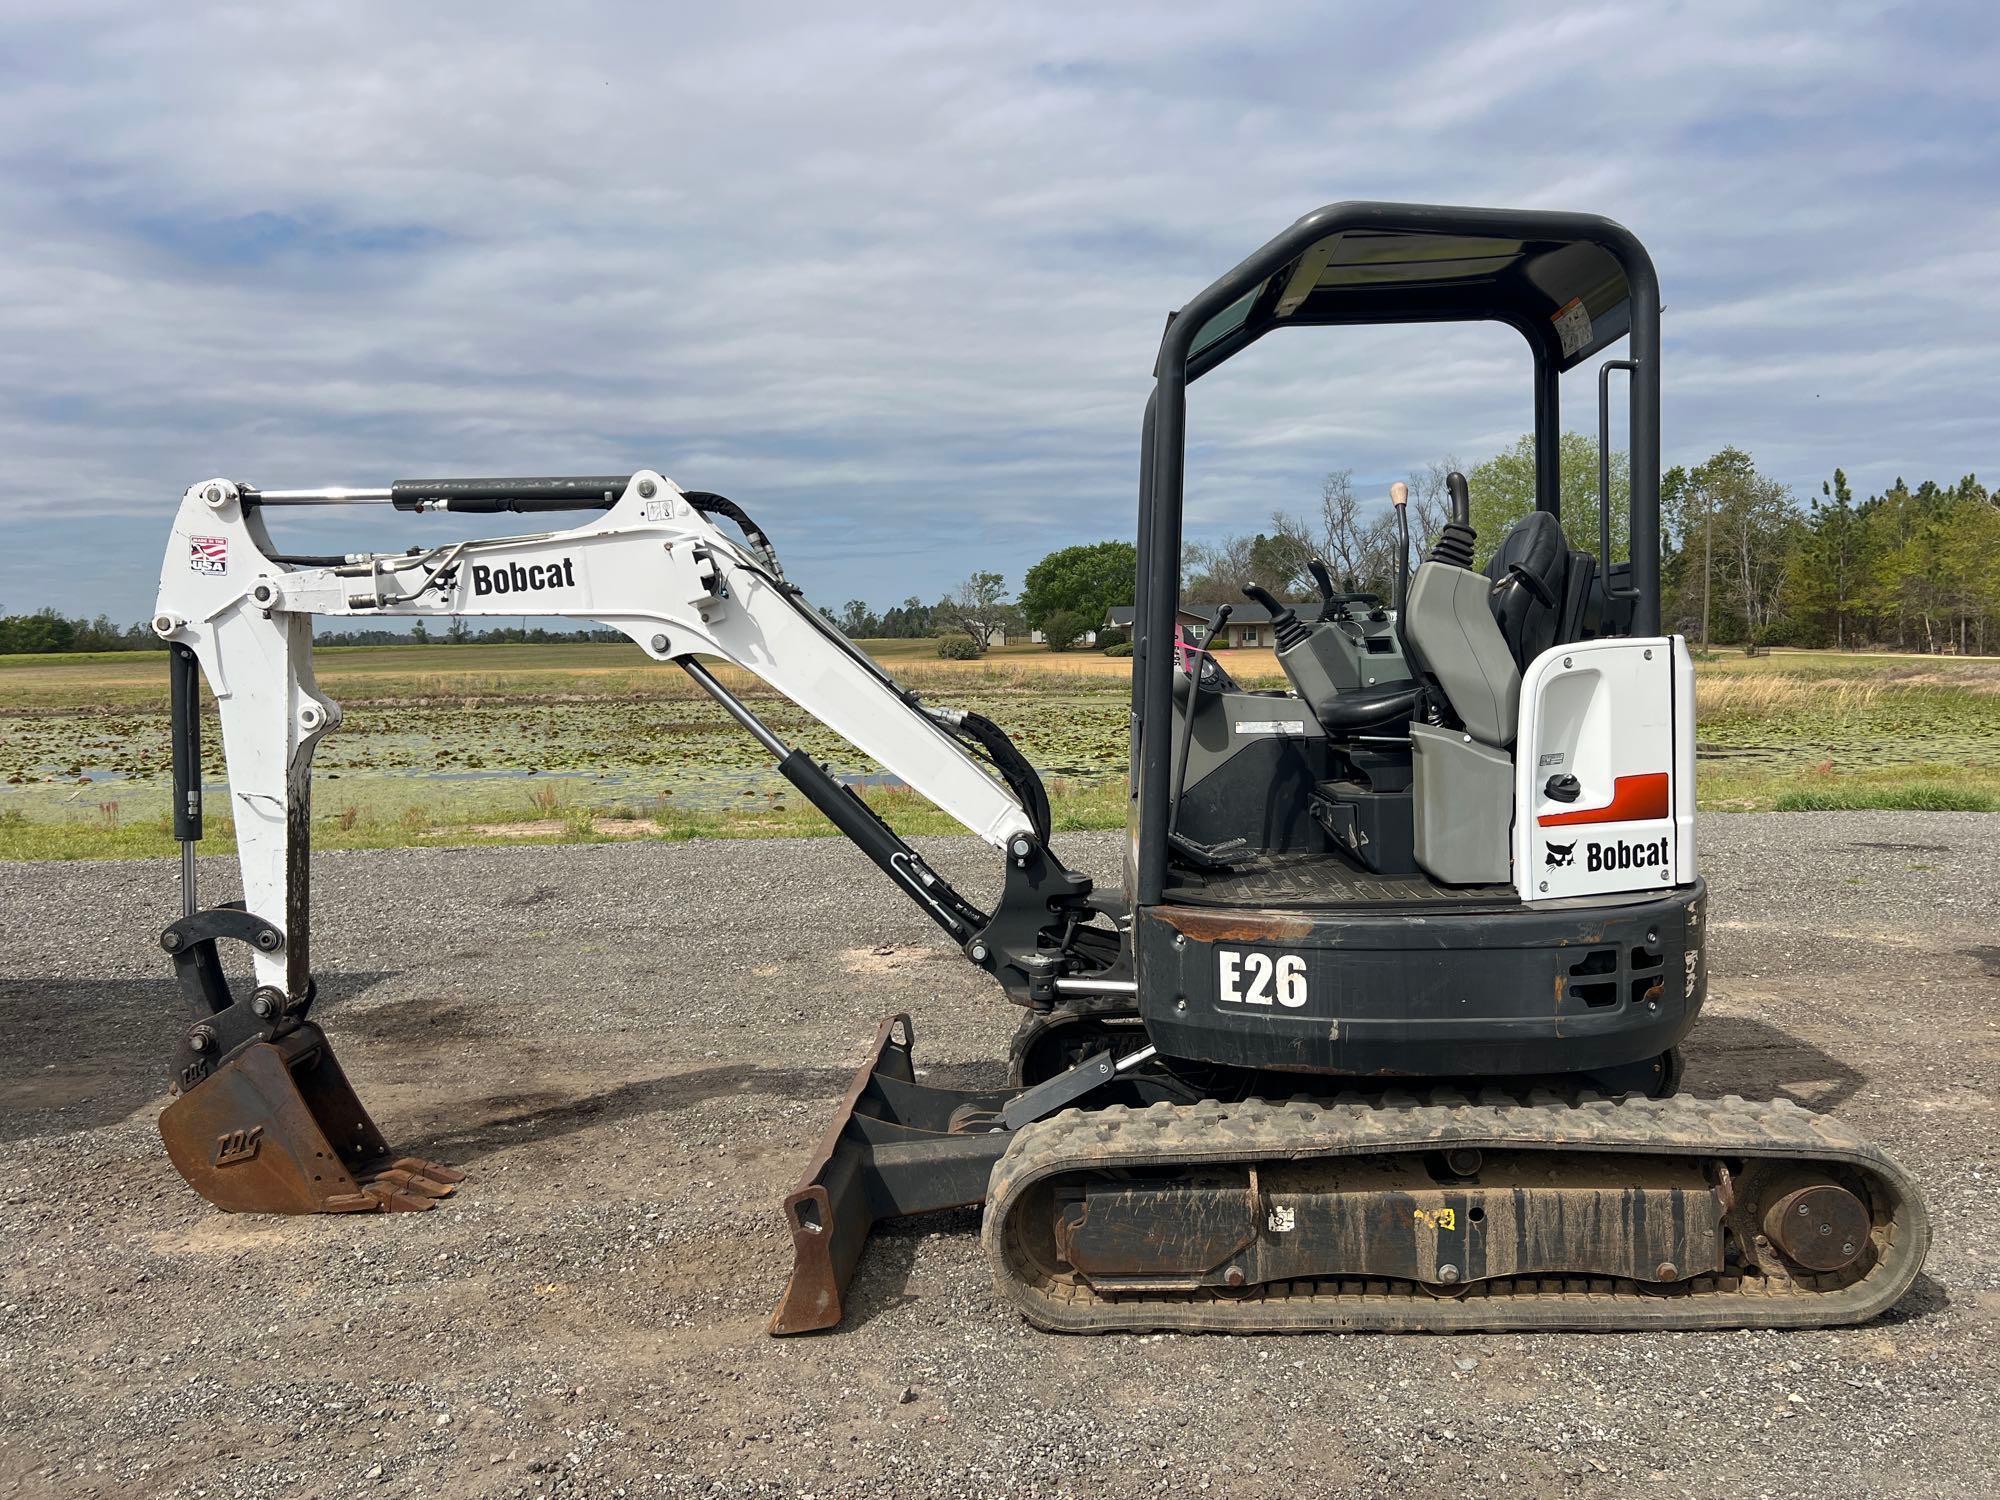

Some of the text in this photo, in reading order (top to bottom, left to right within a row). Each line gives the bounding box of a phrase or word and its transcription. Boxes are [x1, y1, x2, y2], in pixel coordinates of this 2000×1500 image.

[192, 560, 224, 571] USA
[472, 557, 575, 596] Bobcat
[1587, 837, 1669, 872] Bobcat
[1219, 950, 1308, 1008] E26
